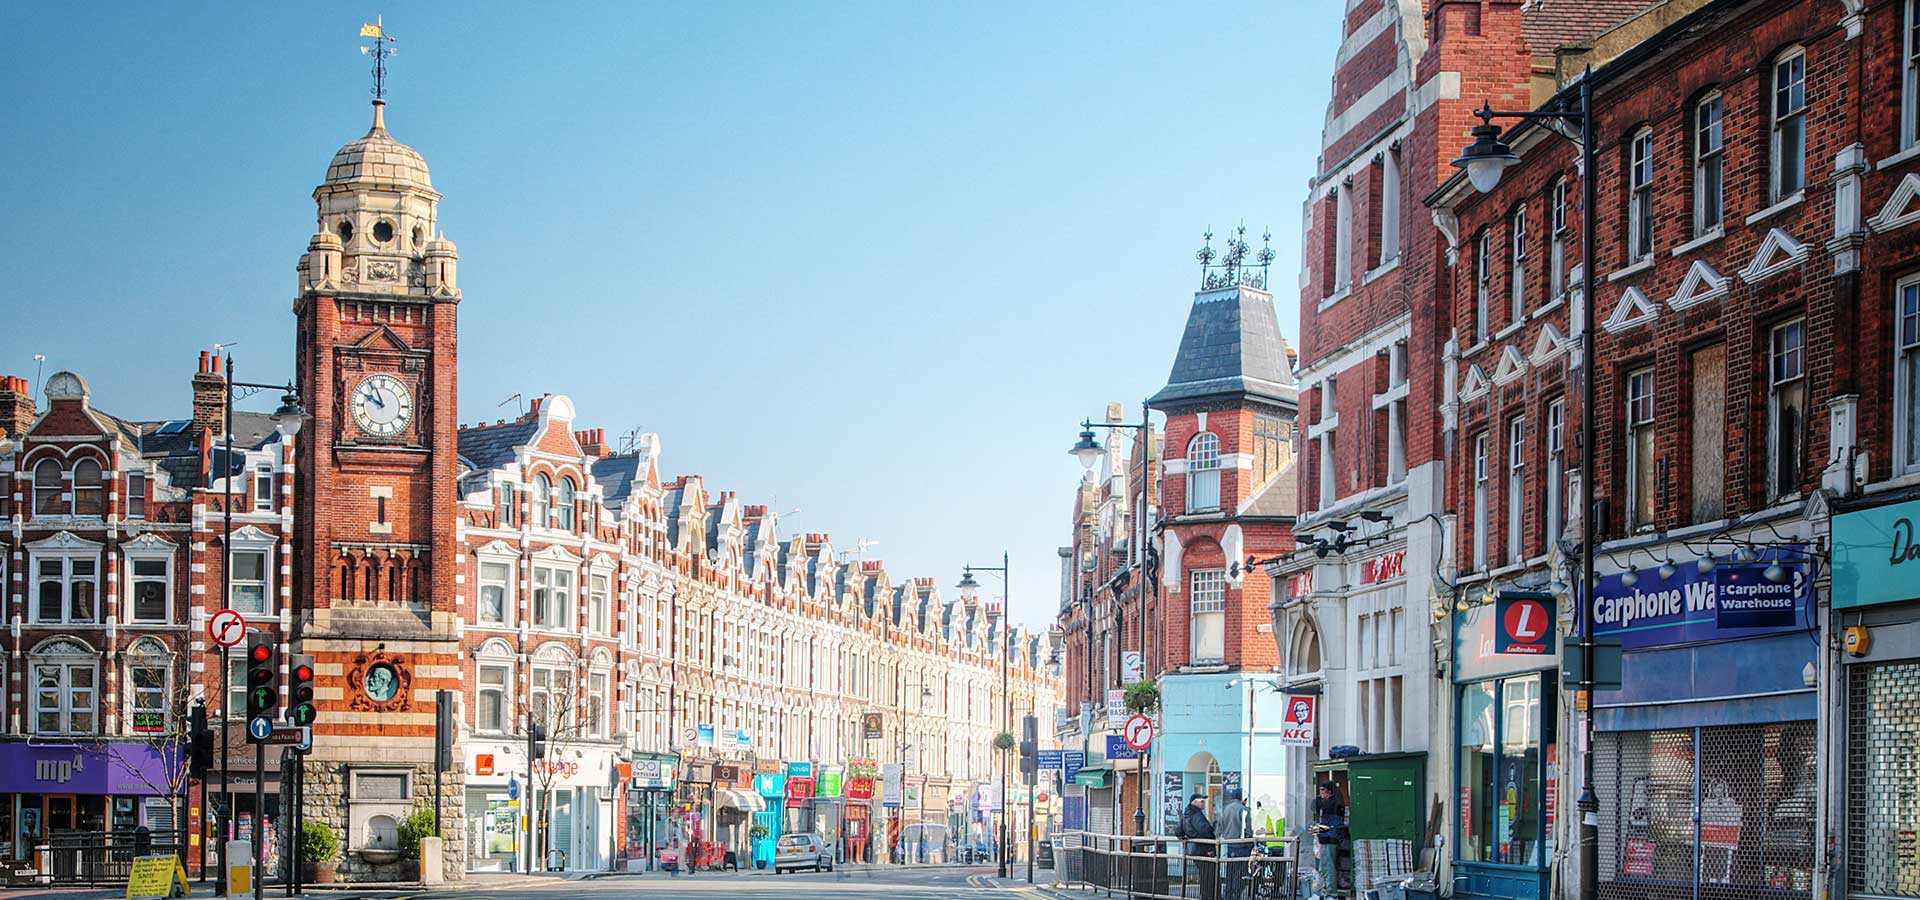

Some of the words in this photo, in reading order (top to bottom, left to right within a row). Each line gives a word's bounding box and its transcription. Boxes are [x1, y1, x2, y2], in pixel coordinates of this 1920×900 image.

[1726, 583, 1792, 596] Carphone
[1593, 588, 1682, 628] Carphone
[1720, 598, 1792, 610] Warehouse
[1515, 604, 1536, 637] L
[1283, 729, 1312, 739] KFC
